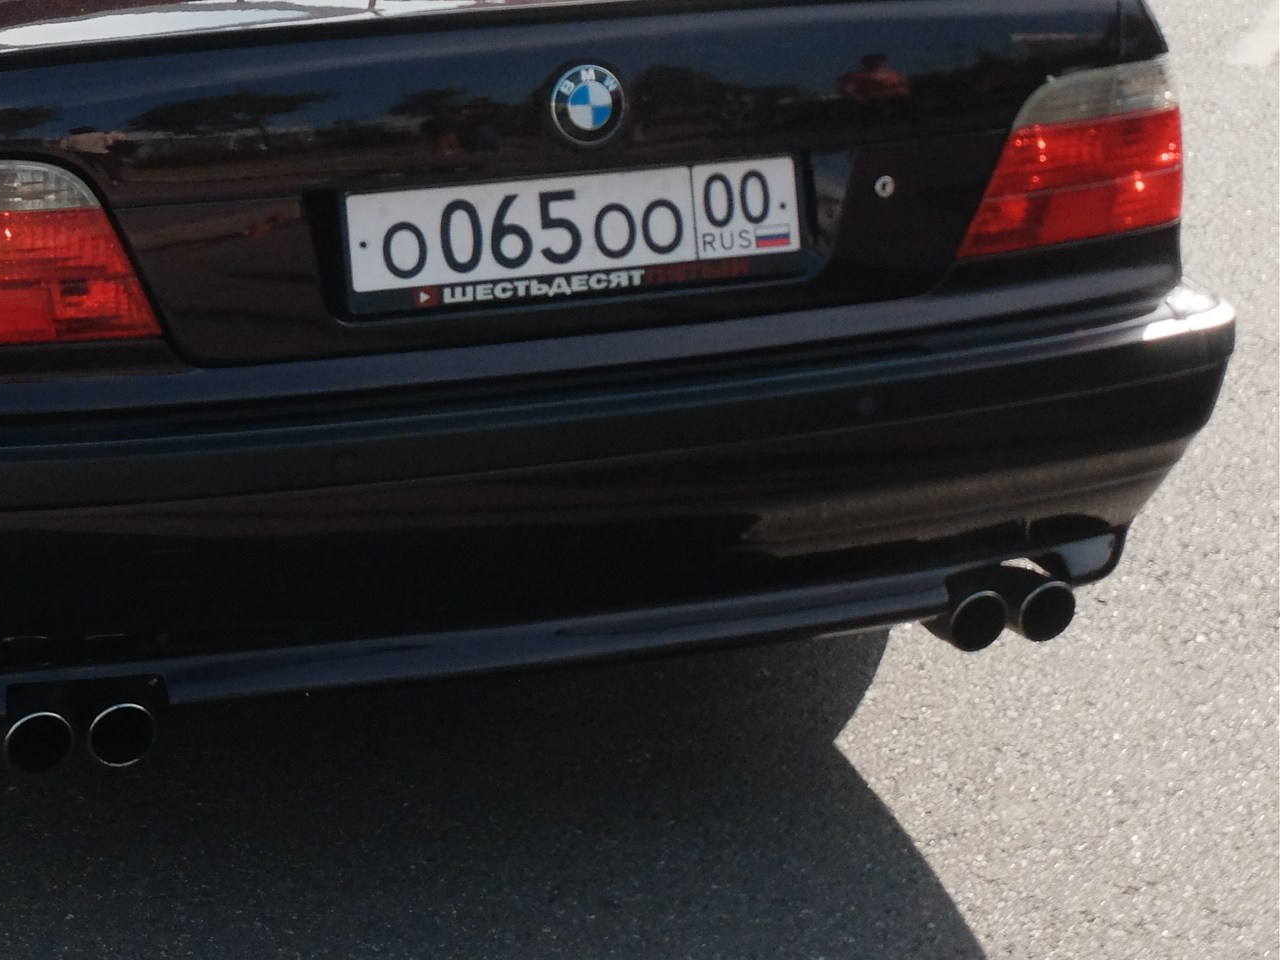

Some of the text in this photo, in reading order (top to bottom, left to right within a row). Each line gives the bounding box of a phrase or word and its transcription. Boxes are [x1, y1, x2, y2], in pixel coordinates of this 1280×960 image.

[560, 68, 619, 96] BMW
[702, 229, 753, 253] RUS
[442, 268, 645, 304] ШЕСТЬДЕСЯТ
